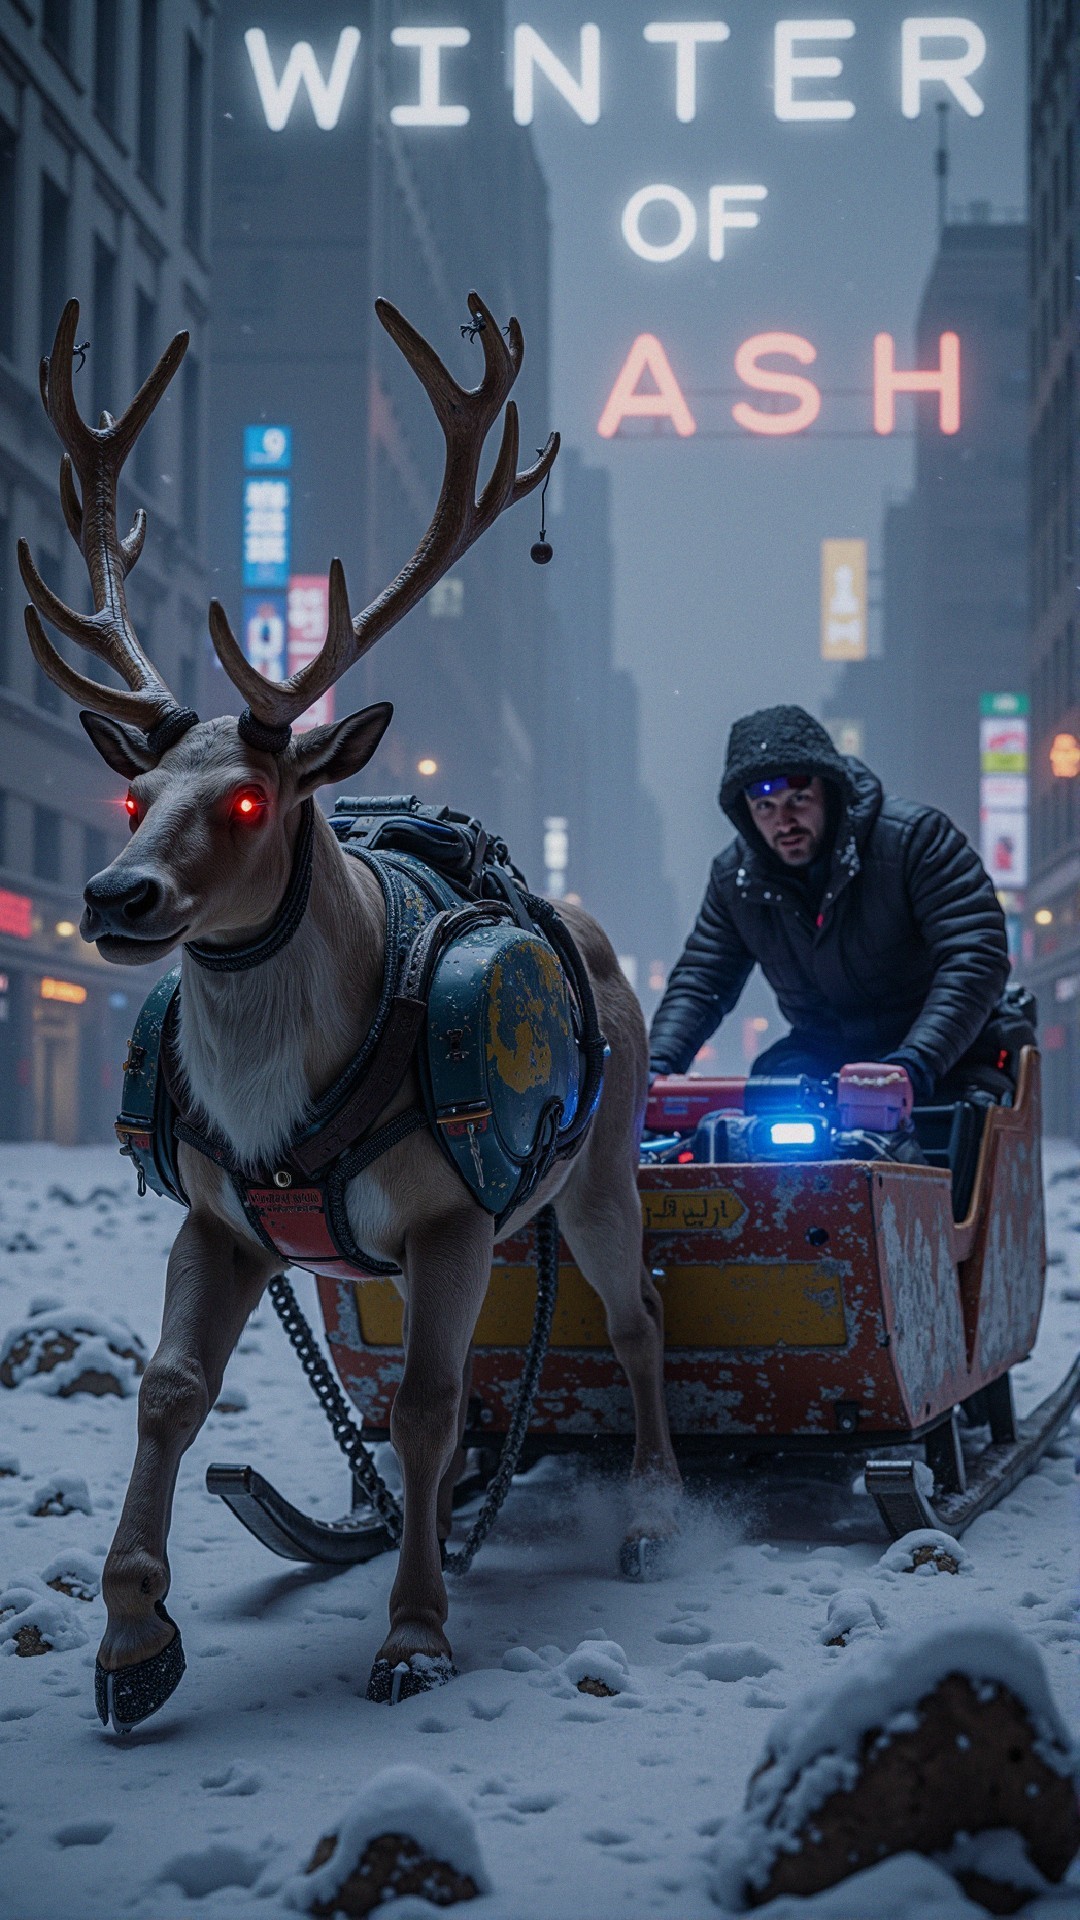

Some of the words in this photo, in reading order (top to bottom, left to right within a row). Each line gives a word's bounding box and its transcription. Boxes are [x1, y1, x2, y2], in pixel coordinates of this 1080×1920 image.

[245, 17, 987, 131] WINTER
[621, 184, 768, 262] OF
[597, 331, 961, 438] ASH
